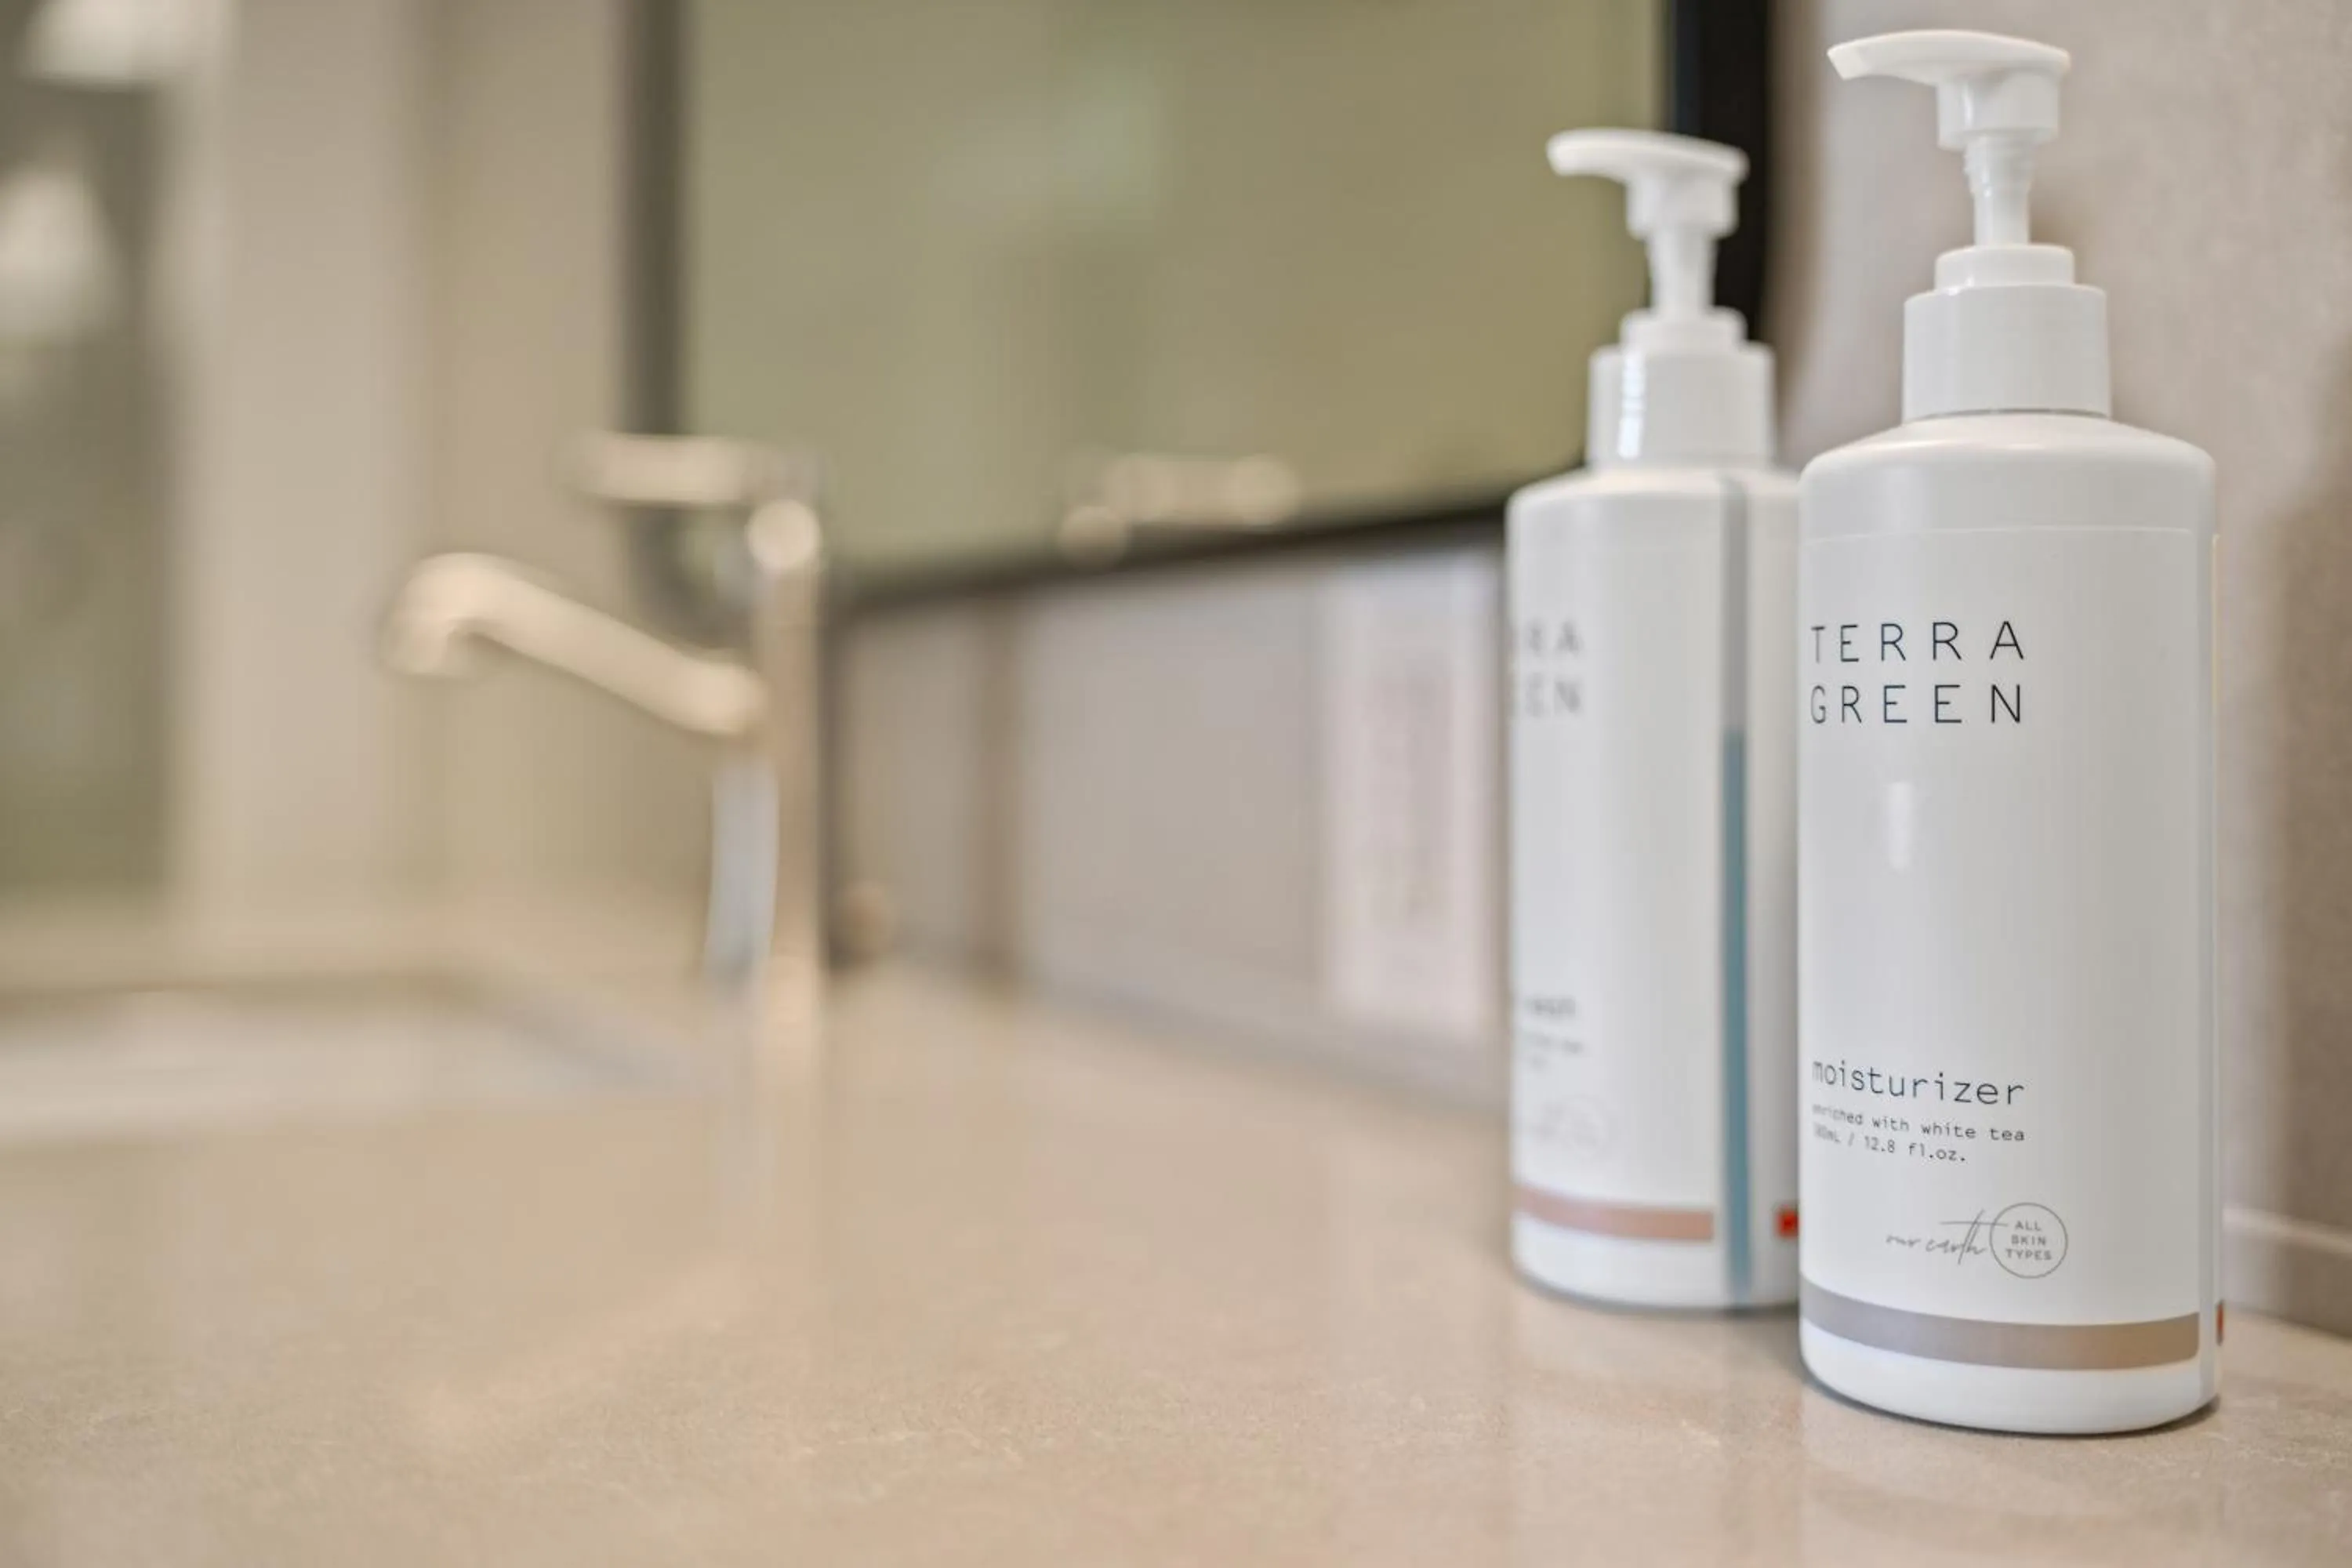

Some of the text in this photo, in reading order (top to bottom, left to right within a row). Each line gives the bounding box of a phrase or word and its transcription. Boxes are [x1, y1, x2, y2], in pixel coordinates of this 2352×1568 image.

[1811, 620, 2024, 663] TERRA
[1810, 684, 2021, 724] GREEN
[1812, 1059, 2025, 1105] moisturizer
[1872, 1116, 1909, 1131] with
[1921, 1121, 1976, 1140] white
[1990, 1128, 2025, 1142] tea
[1848, 1132, 1855, 1147] /
[1864, 1135, 1896, 1153] 12.8
[1908, 1142, 1967, 1162] fl.oz.
[1926, 1208, 2009, 1265] earth
[2011, 1234, 2047, 1246] SKIN
[2014, 1220, 2042, 1232] ALL
[2005, 1248, 2053, 1261] TYPES
